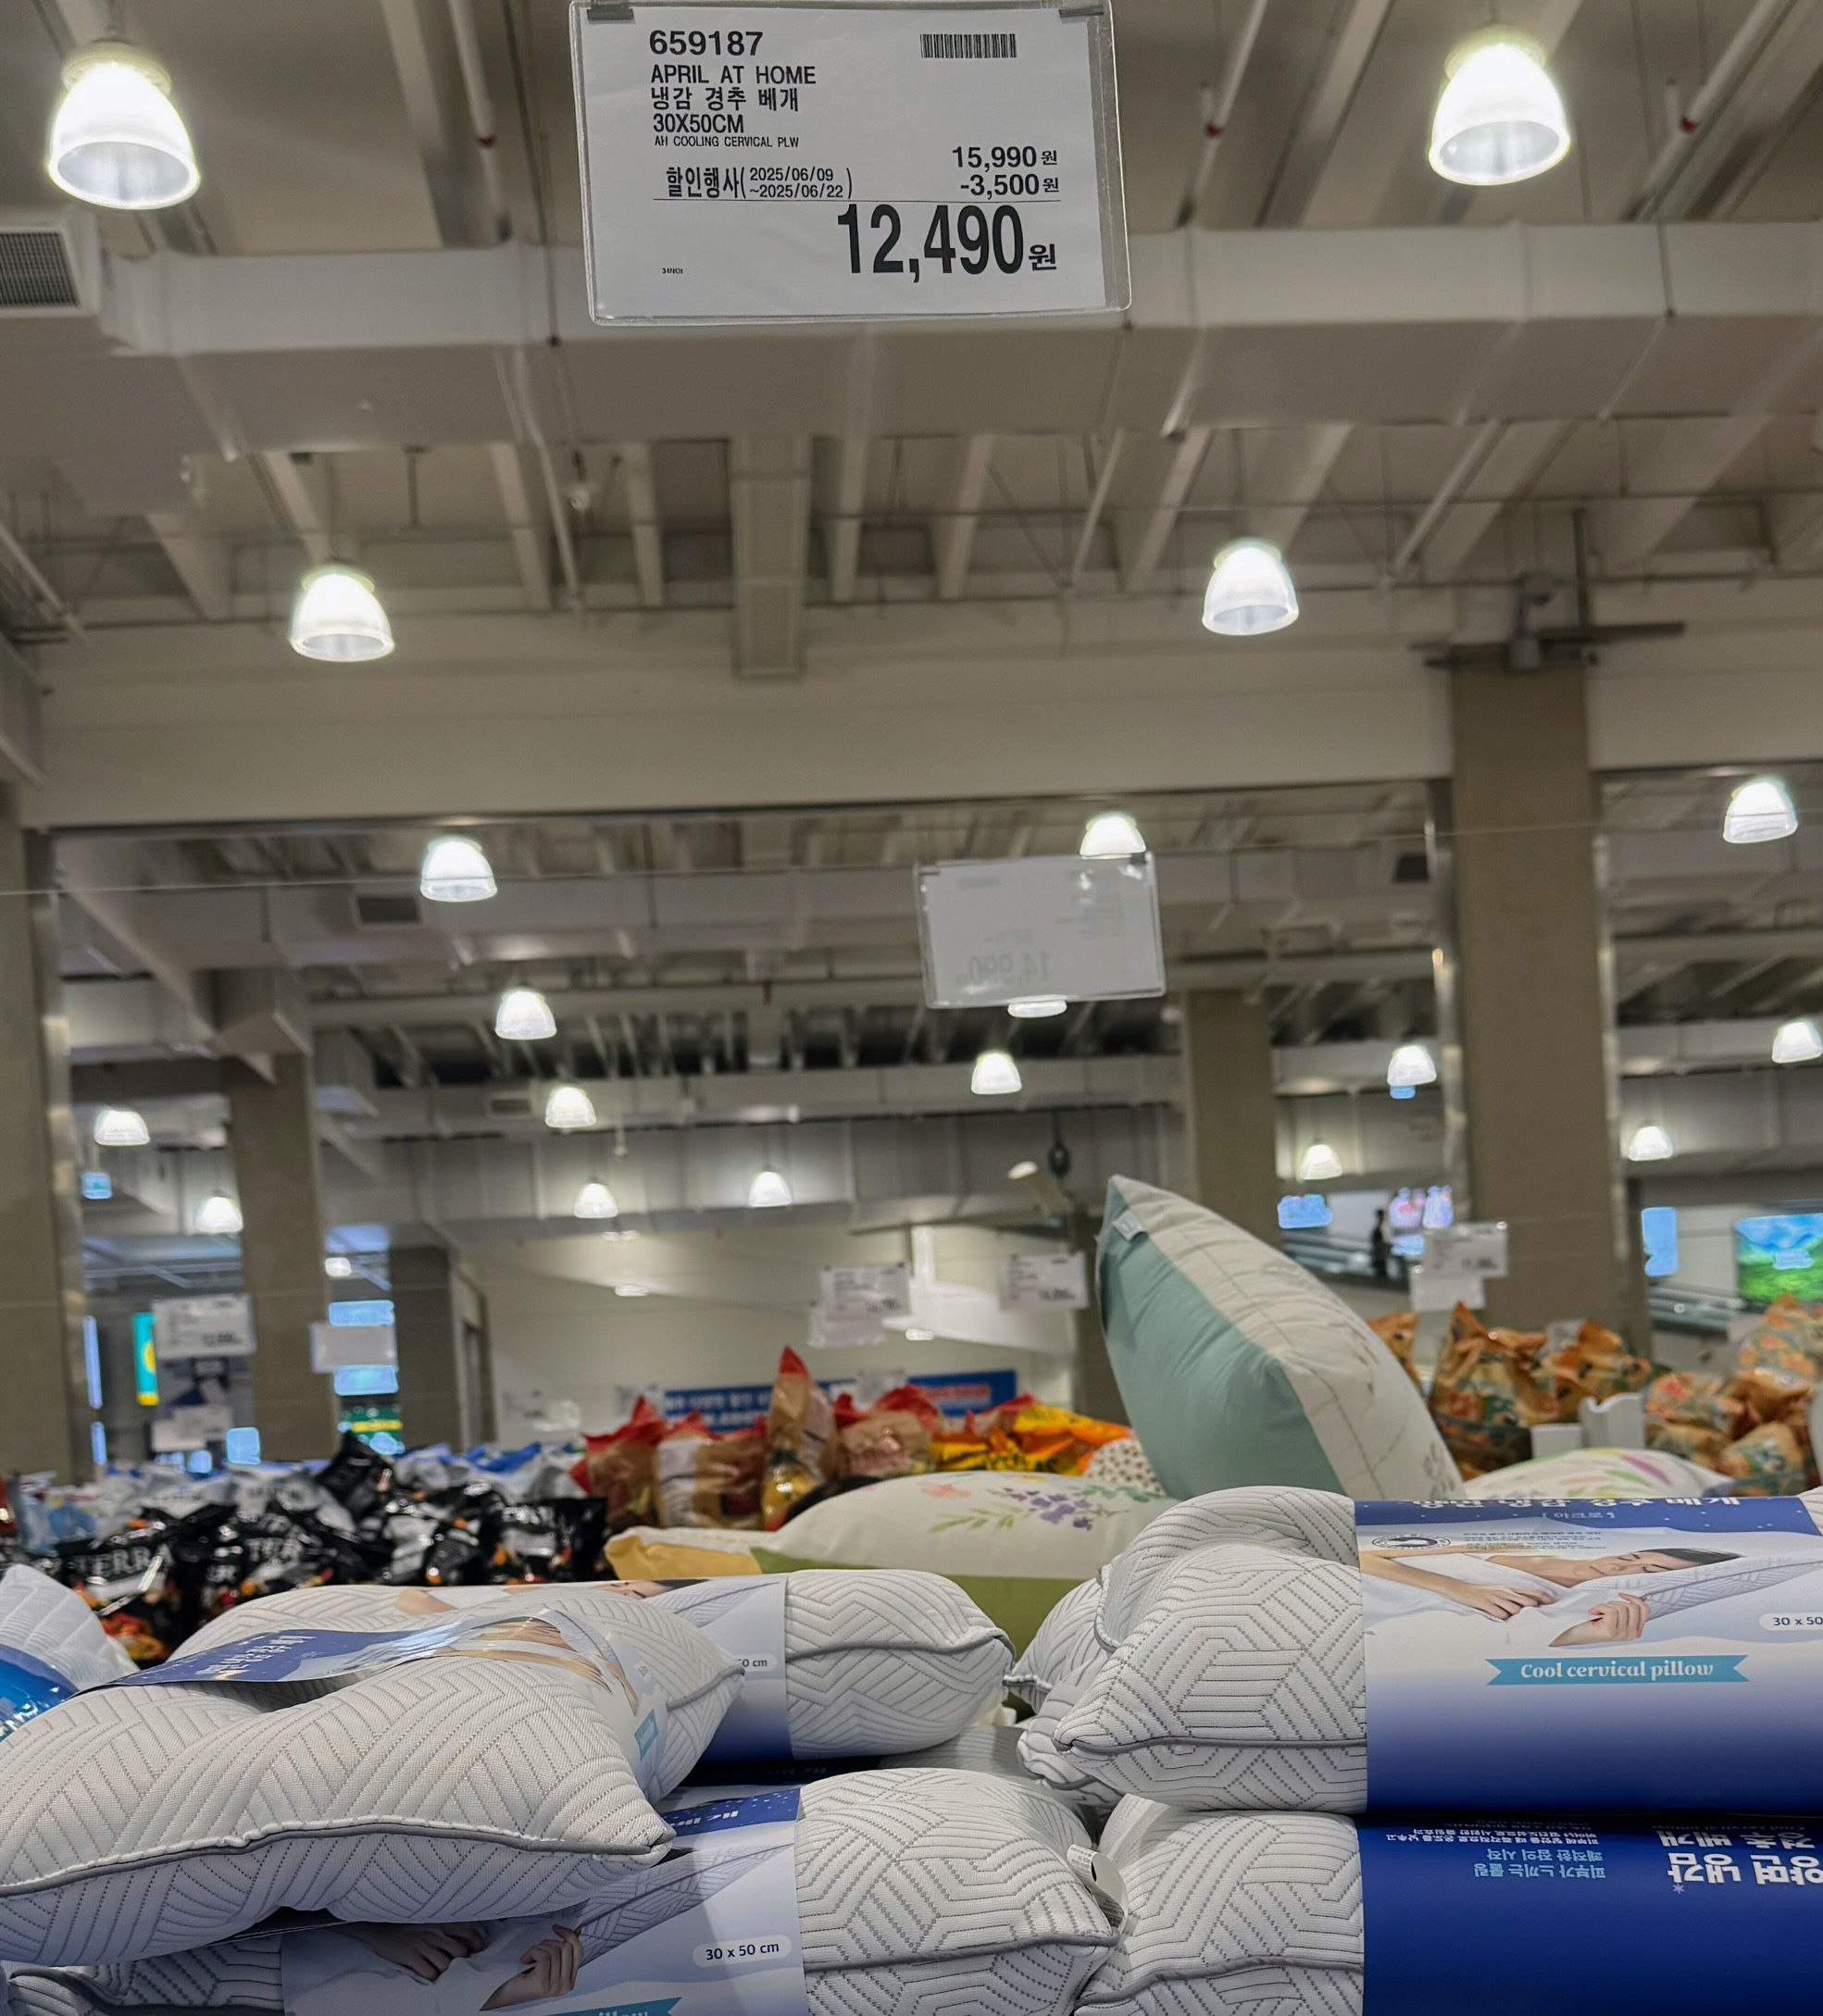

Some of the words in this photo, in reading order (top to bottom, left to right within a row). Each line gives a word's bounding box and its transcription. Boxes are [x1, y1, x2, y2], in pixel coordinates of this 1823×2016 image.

[649, 30, 764, 56] 659187
[651, 65, 709, 84] APRIL
[720, 65, 744, 84] AT
[755, 66, 817, 85] HOME
[651, 86, 693, 111] 냉감
[705, 87, 747, 112] 경추
[758, 87, 799, 112] 베개
[653, 114, 744, 133] 30X50CM
[655, 135, 668, 146] AH
[673, 135, 719, 147] COOLING
[724, 136, 772, 148] CERVICAL
[778, 137, 799, 148] PLW
[749, 168, 834, 181] 2025/06/09
[1773, 1616, 1791, 1626] 30
[1794, 1618, 1804, 1626] x
[1806, 1616, 1823, 1625] 50
[738, 1659, 749, 1667] 0
[753, 1659, 768, 1667] cm
[1520, 1662, 1562, 1679] Cool
[1567, 1661, 1646, 1678] cervical
[1651, 1660, 1714, 1682] pillow
[1655, 1830, 1732, 1848] 베개
[1740, 1832, 1816, 1850] 경추
[1487, 1848, 1517, 1861] 시작
[1521, 1848, 1553, 1861] 잠의
[1556, 1849, 1604, 1862] 쾌적한
[1474, 1862, 1504, 1878] 쿨링
[1508, 1863, 1555, 1878] 느끼는
[1559, 1864, 1606, 1879] 피부가
[1667, 1852, 1742, 1884] 냉감
[1750, 1854, 1823, 1885] 양면
[705, 1948, 723, 1960] 30
[727, 1948, 736, 1959] x
[739, 1944, 755, 1957] 50
[759, 1943, 780, 1954] cm
